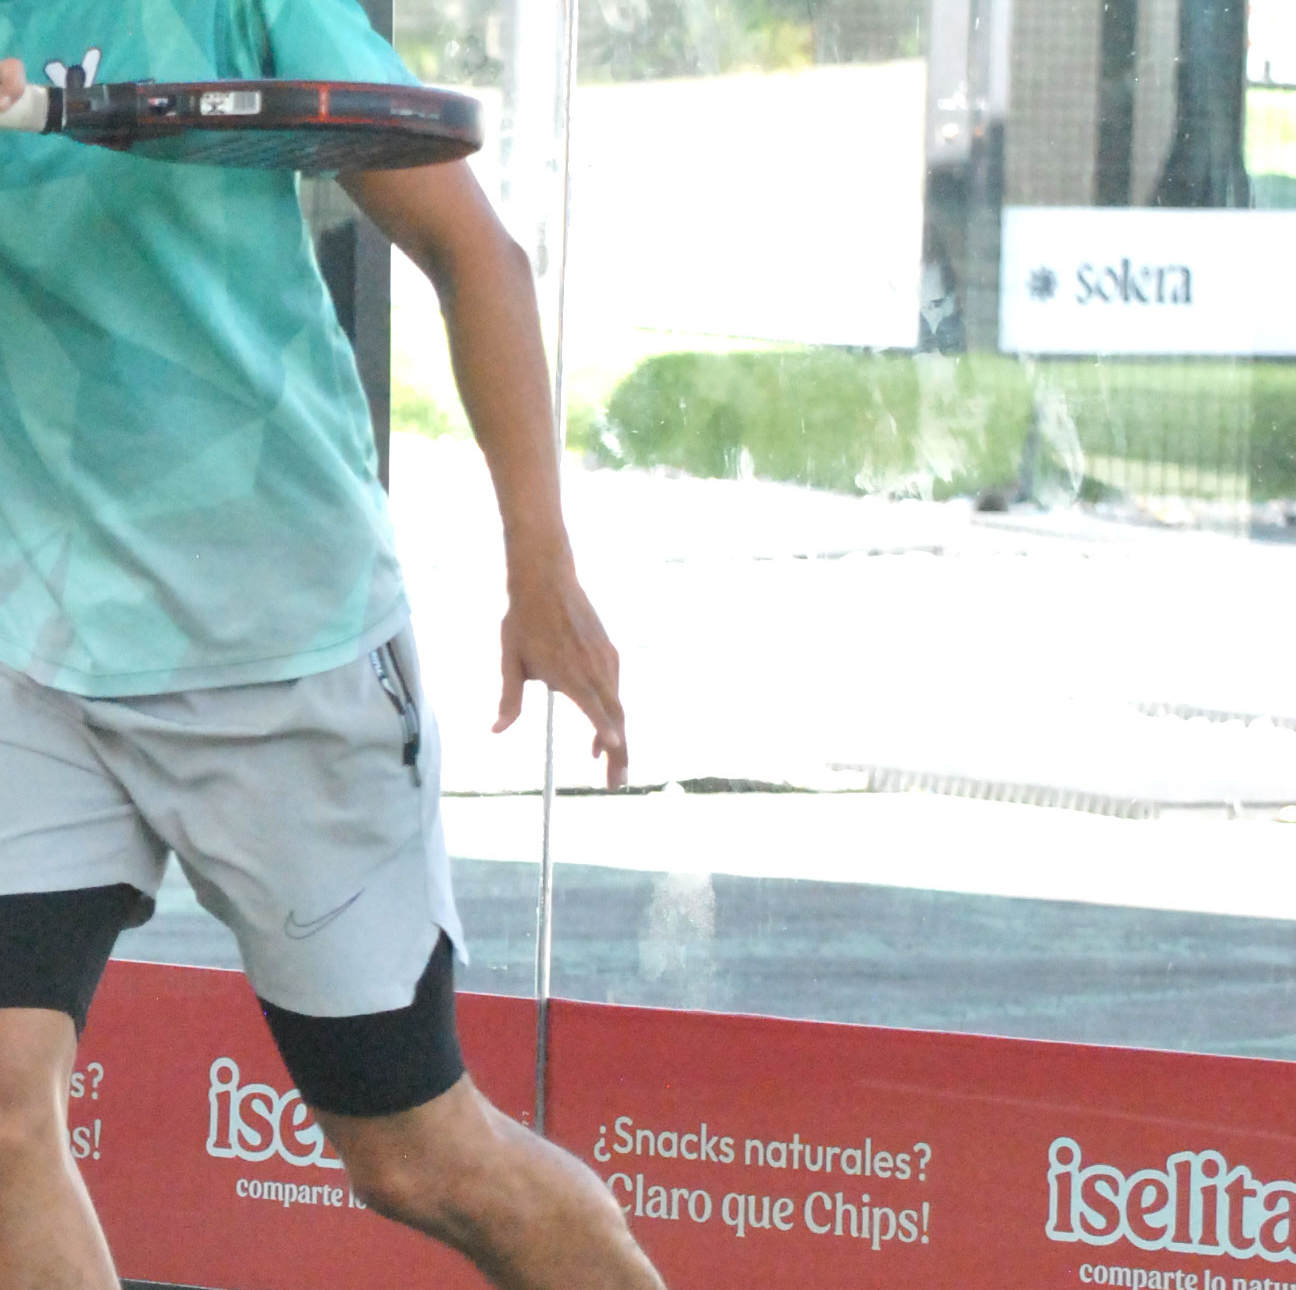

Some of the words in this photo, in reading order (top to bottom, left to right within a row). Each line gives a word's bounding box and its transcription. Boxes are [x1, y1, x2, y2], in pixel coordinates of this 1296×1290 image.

[1075, 257, 1193, 305] solera
[593, 1116, 735, 1163] ¿Snacks
[745, 1133, 932, 1181] naturales?
[236, 1178, 343, 1207] comparte
[605, 1173, 712, 1223] Claro
[721, 1191, 794, 1237] que
[804, 1191, 930, 1250] Chips!
